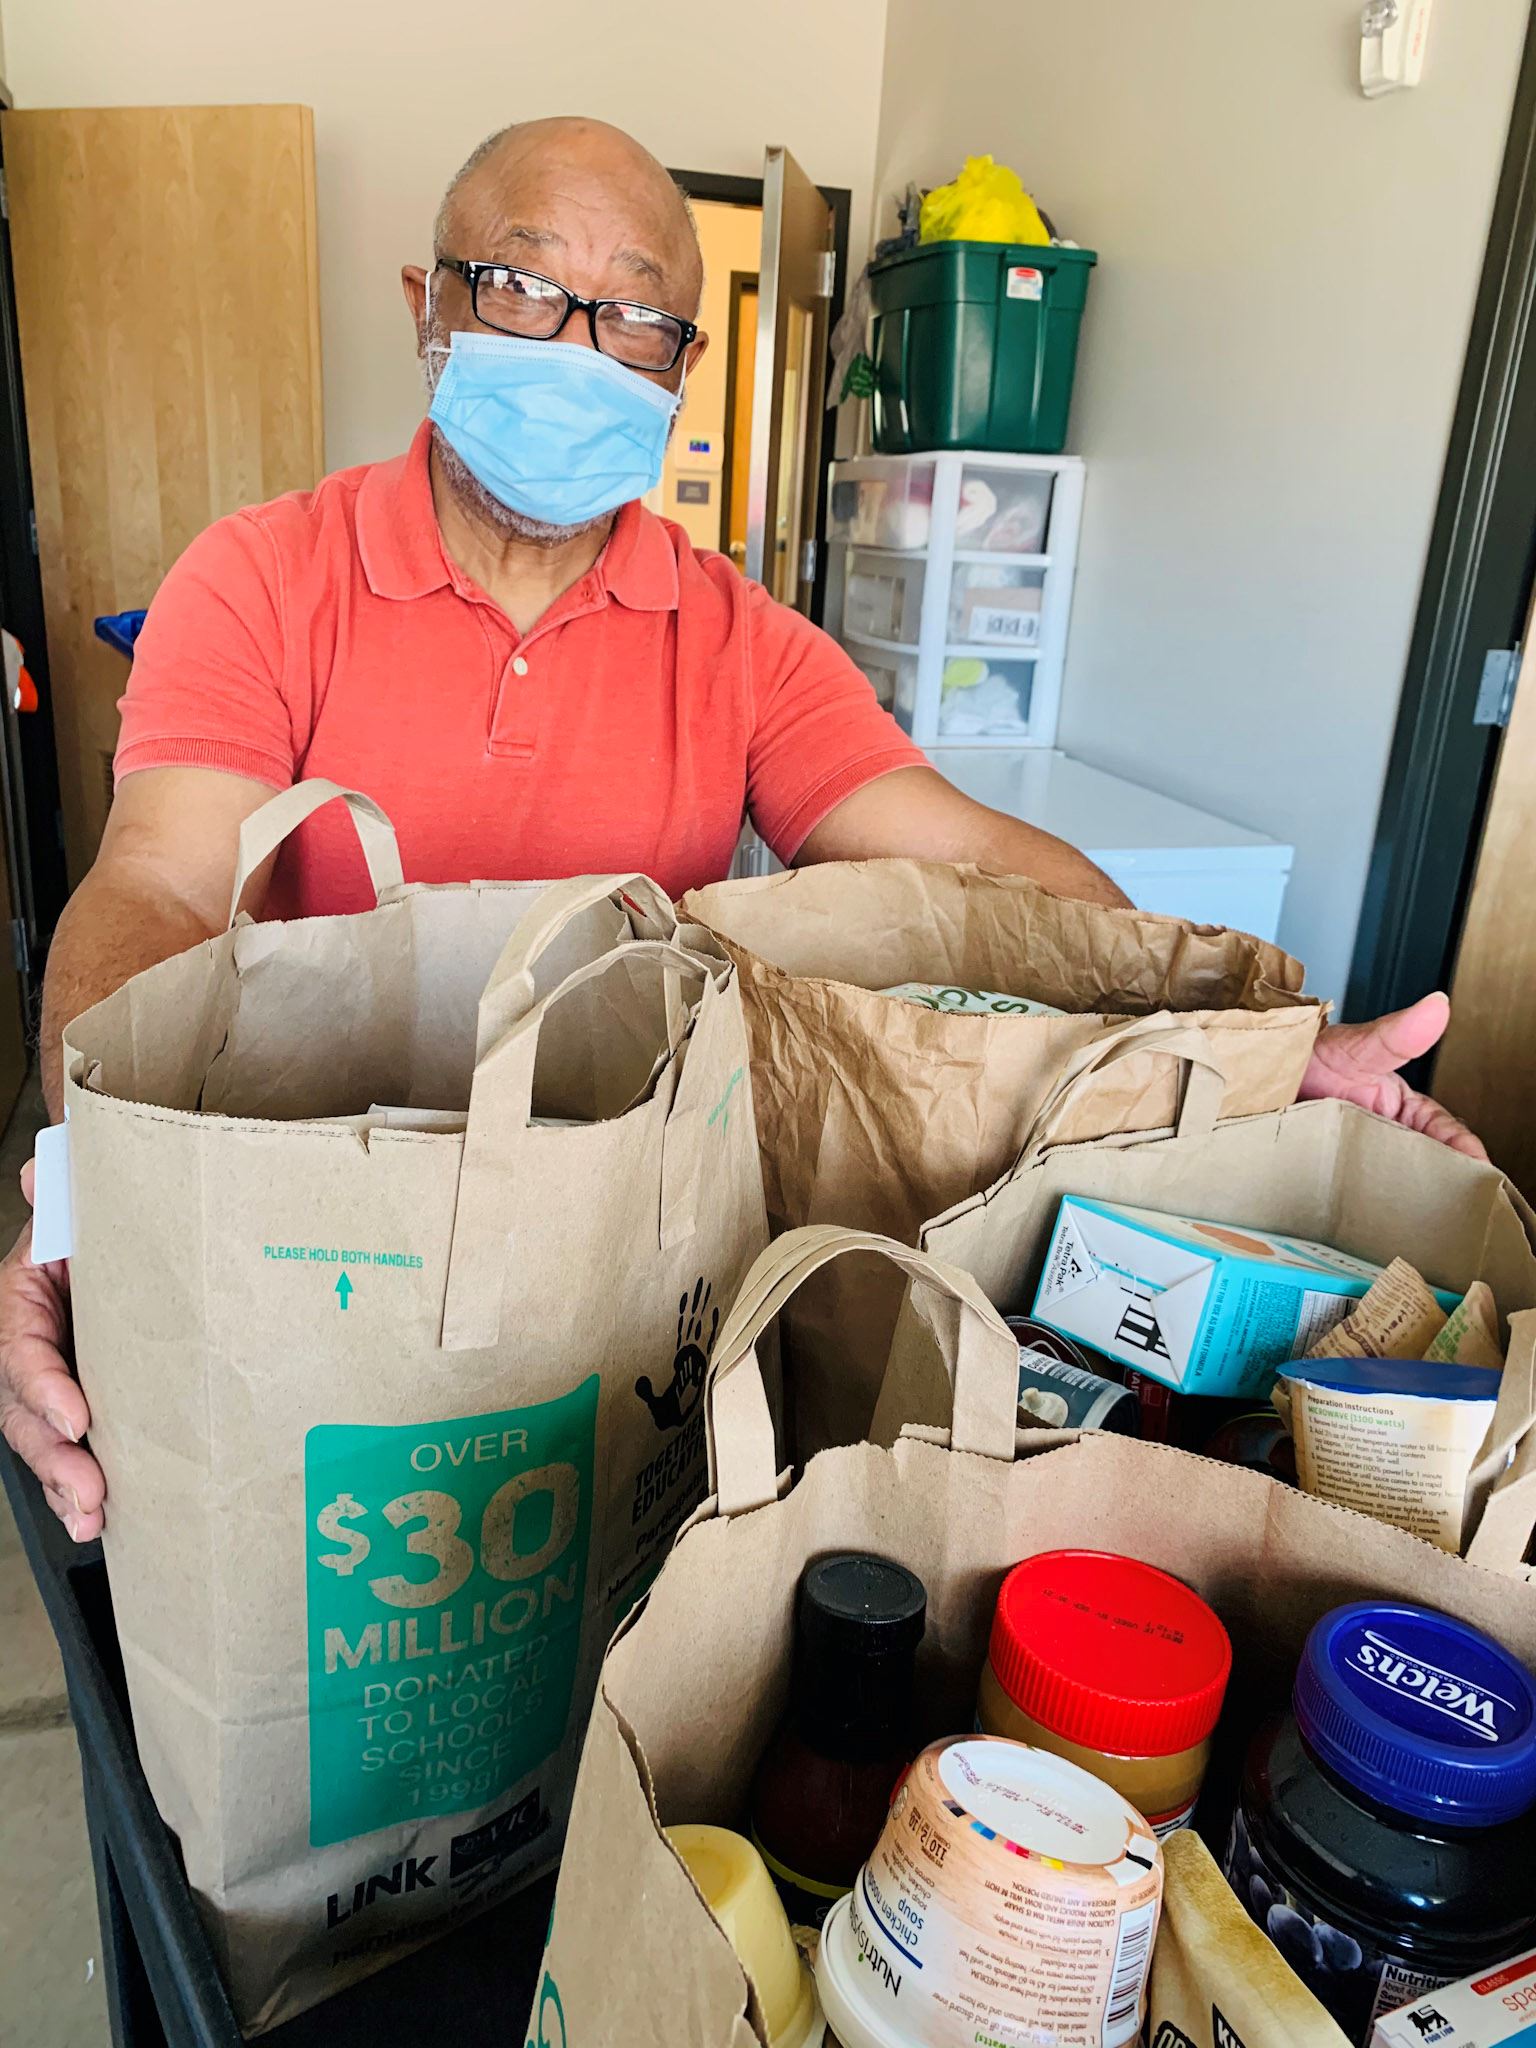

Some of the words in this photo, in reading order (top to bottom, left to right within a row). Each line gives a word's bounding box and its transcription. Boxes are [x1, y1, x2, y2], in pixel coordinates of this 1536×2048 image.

[264, 1246, 307, 1260] PLEASE
[309, 1248, 339, 1262] HOLD
[341, 1251, 371, 1264] BOTH
[373, 1253, 423, 1269] HANDLES
[1059, 1241, 1074, 1266] Tetra
[1208, 1316, 1218, 1325] AS
[1201, 1325, 1216, 1346] INFANT
[1193, 1347, 1209, 1376] FORMULA
[1307, 1395, 1343, 1409] Preparation
[1344, 1401, 1393, 1416] Instructions
[1308, 1406, 1348, 1420] MICROWAVE
[410, 1428, 528, 1472] OVER
[317, 1462, 579, 1608] $30
[324, 1563, 577, 1674] MILLION
[364, 1635, 548, 1708] DONATED
[1357, 1645, 1496, 1730] Welch's
[1456, 1681, 1484, 1697] FAMILY
[358, 1711, 412, 1740] TO
[429, 1664, 547, 1725] LOCAL
[361, 1689, 544, 1771] SCHOOLS
[401, 1732, 512, 1785] SINCE
[929, 1840, 947, 1861] 110
[327, 1856, 438, 1929] LINK
[1001, 1888, 1009, 1896] BE
[1009, 1892, 1023, 1903] WILL
[1041, 1892, 1066, 1904] UNUSED
[911, 1894, 928, 1910] soup
[1025, 1898, 1042, 1908] BOWL
[1043, 1904, 1058, 1912] AND
[1082, 1899, 1116, 1907] REFRIGERATE
[898, 1898, 925, 1930] soup
[1059, 1907, 1087, 1917] PRODUCT
[881, 1901, 919, 1948] chicken
[850, 1893, 902, 1998] Nutrisys
[971, 1969, 999, 1988] MEDIUM
[1384, 1981, 1405, 1995] About
[1477, 1974, 1509, 1993] CLASSIC
[1025, 1990, 1039, 1998] and
[1380, 1990, 1405, 2004] Serv
[987, 2006, 1002, 2016] and
[1003, 2012, 1026, 2023] remain
[1424, 2032, 1441, 2044] FOOD
[1439, 2025, 1456, 2040] LION
